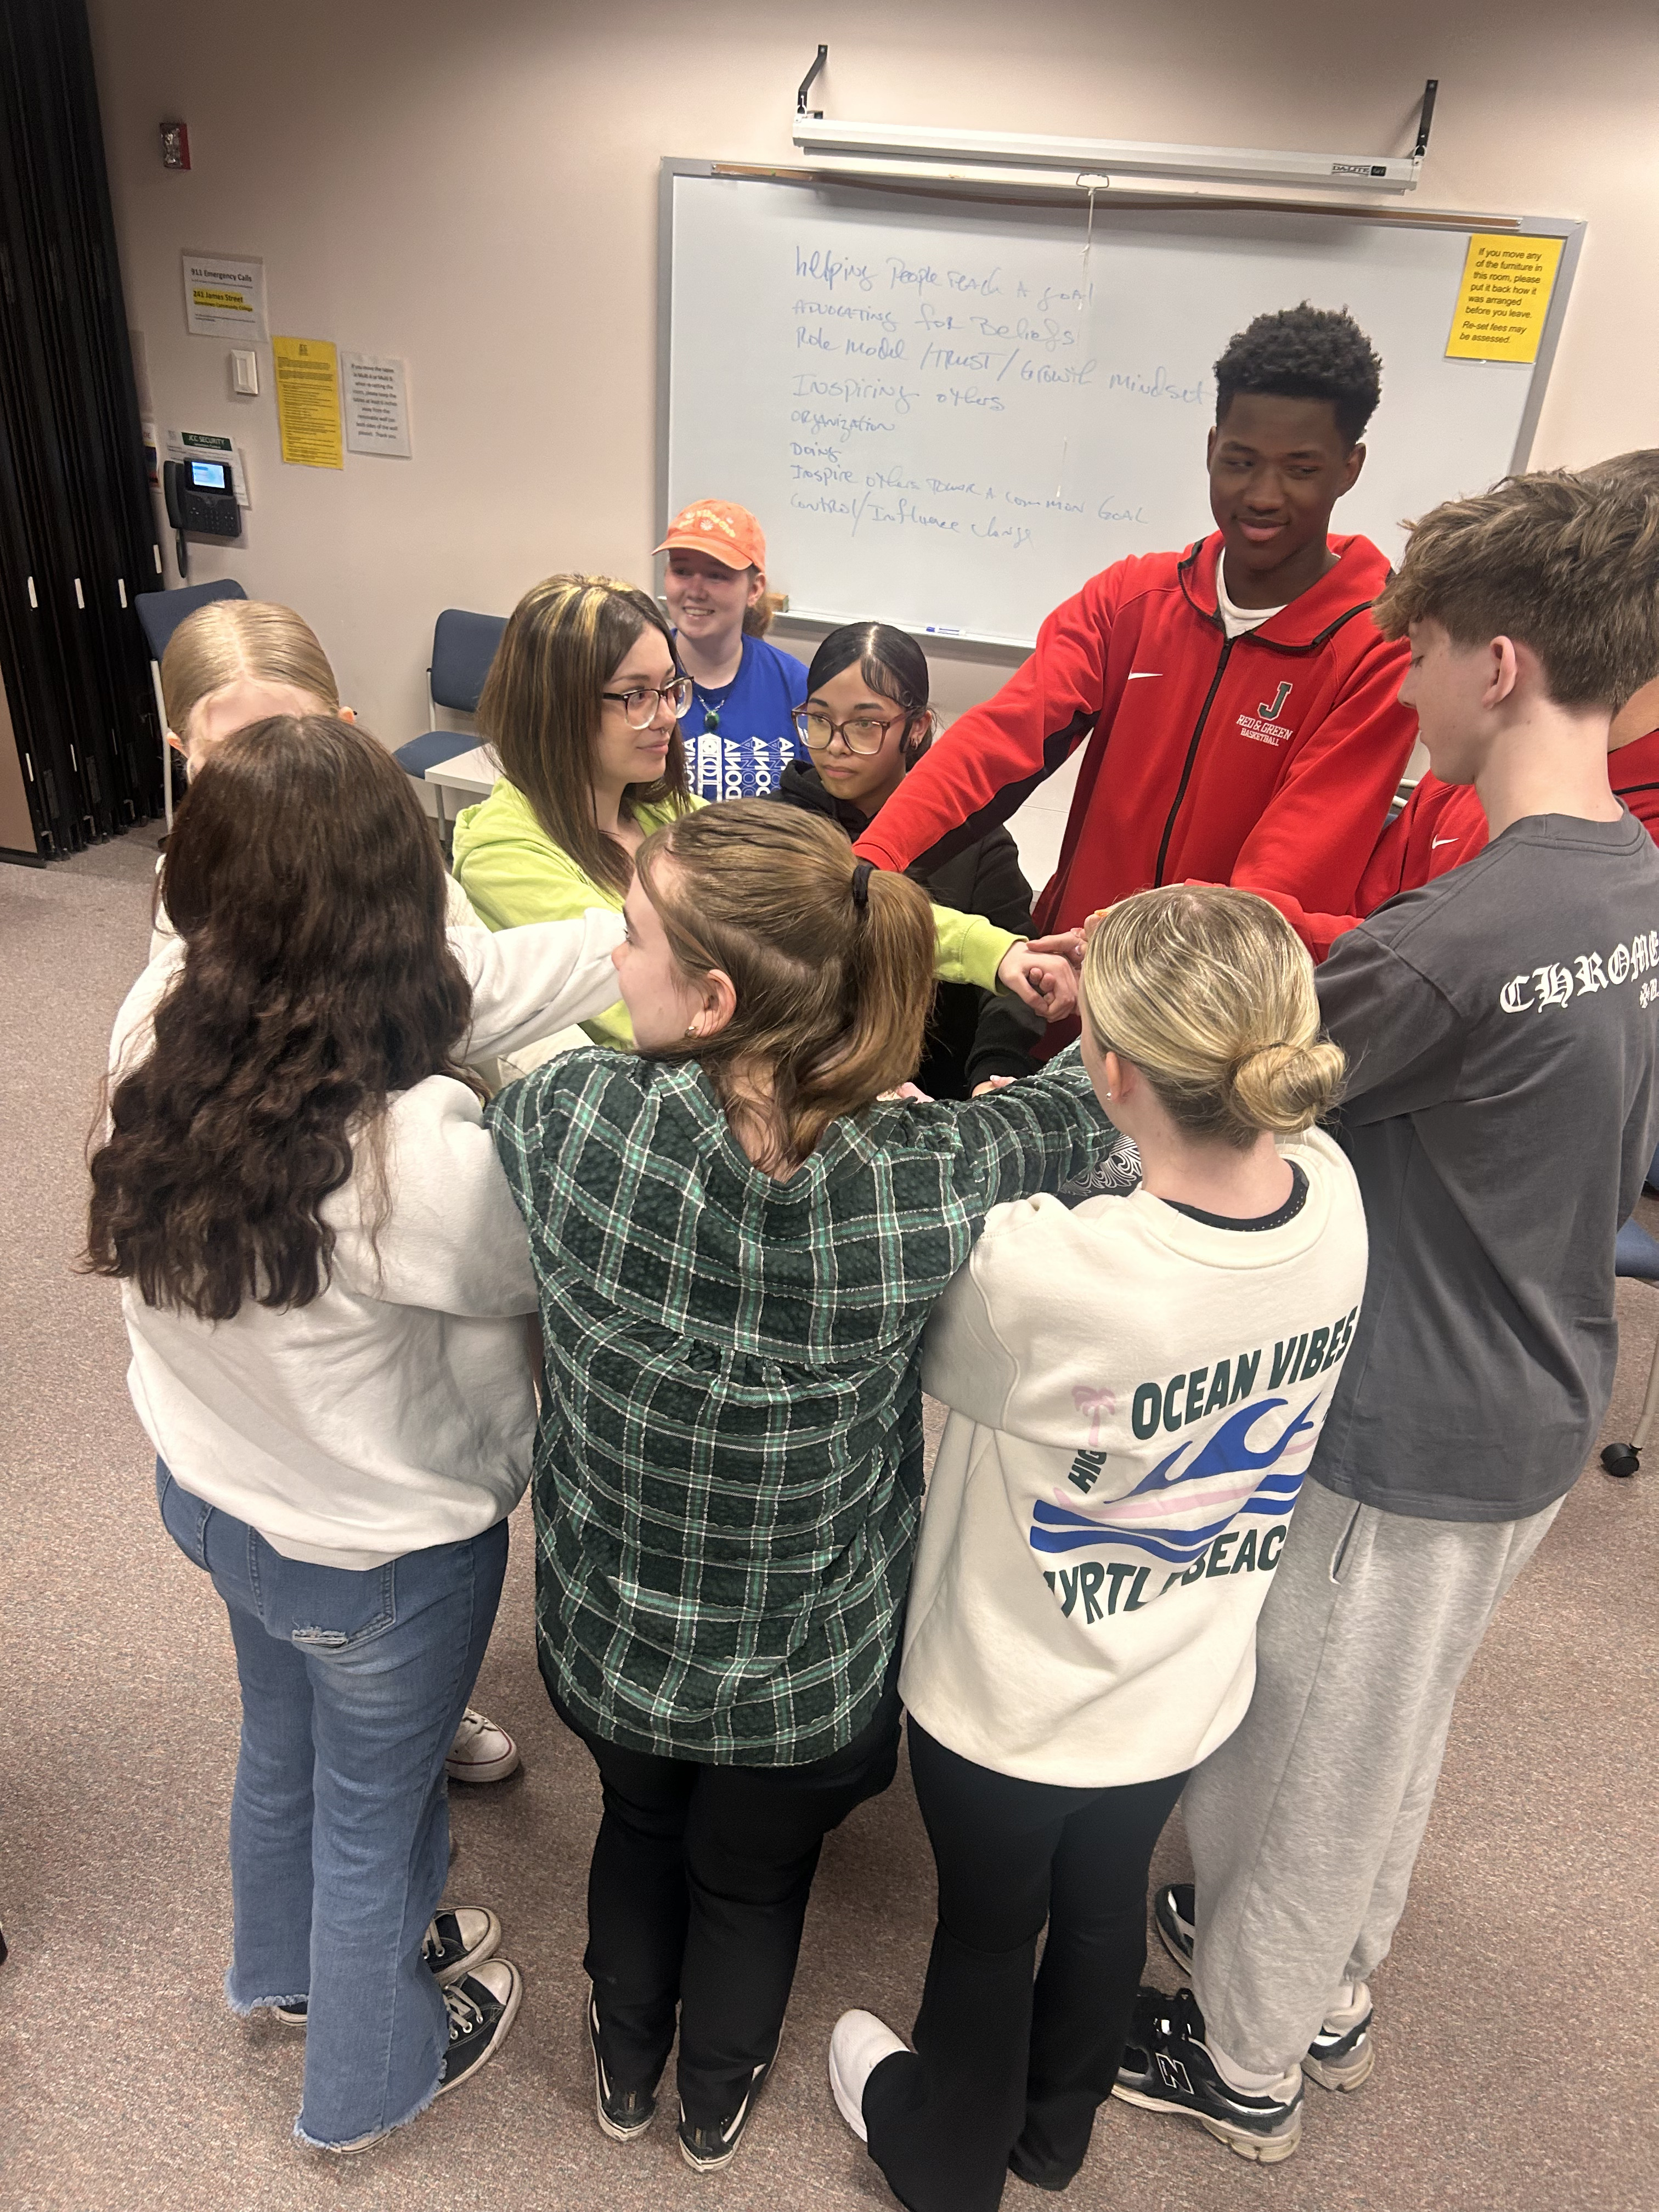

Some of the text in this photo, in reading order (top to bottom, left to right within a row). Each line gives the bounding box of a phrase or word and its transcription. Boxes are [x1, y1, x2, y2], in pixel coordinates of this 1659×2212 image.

[1479, 247, 1543, 262] If you move any
[1485, 261, 1499, 269] the
[1500, 261, 1533, 271] furniture
[1534, 264, 1543, 272] in
[203, 270, 236, 281] Emergency
[238, 273, 252, 282] Calls
[1473, 271, 1541, 284] this room, please
[1470, 284, 1537, 295] put it back how it
[1486, 297, 1522, 307] arranged
[1465, 306, 1532, 318] before you leave.
[1489, 323, 1508, 332] fees
[1508, 325, 1527, 335] may
[1459, 332, 1510, 343] be assessed.
[1257, 681, 1293, 721] J
[1240, 727, 1279, 747] BASKETBALL
[1500, 930, 1659, 1014] CHROME
[1132, 1305, 1358, 1441] OCEAN VIBES
[1043, 1561, 1184, 1624] YRTL
